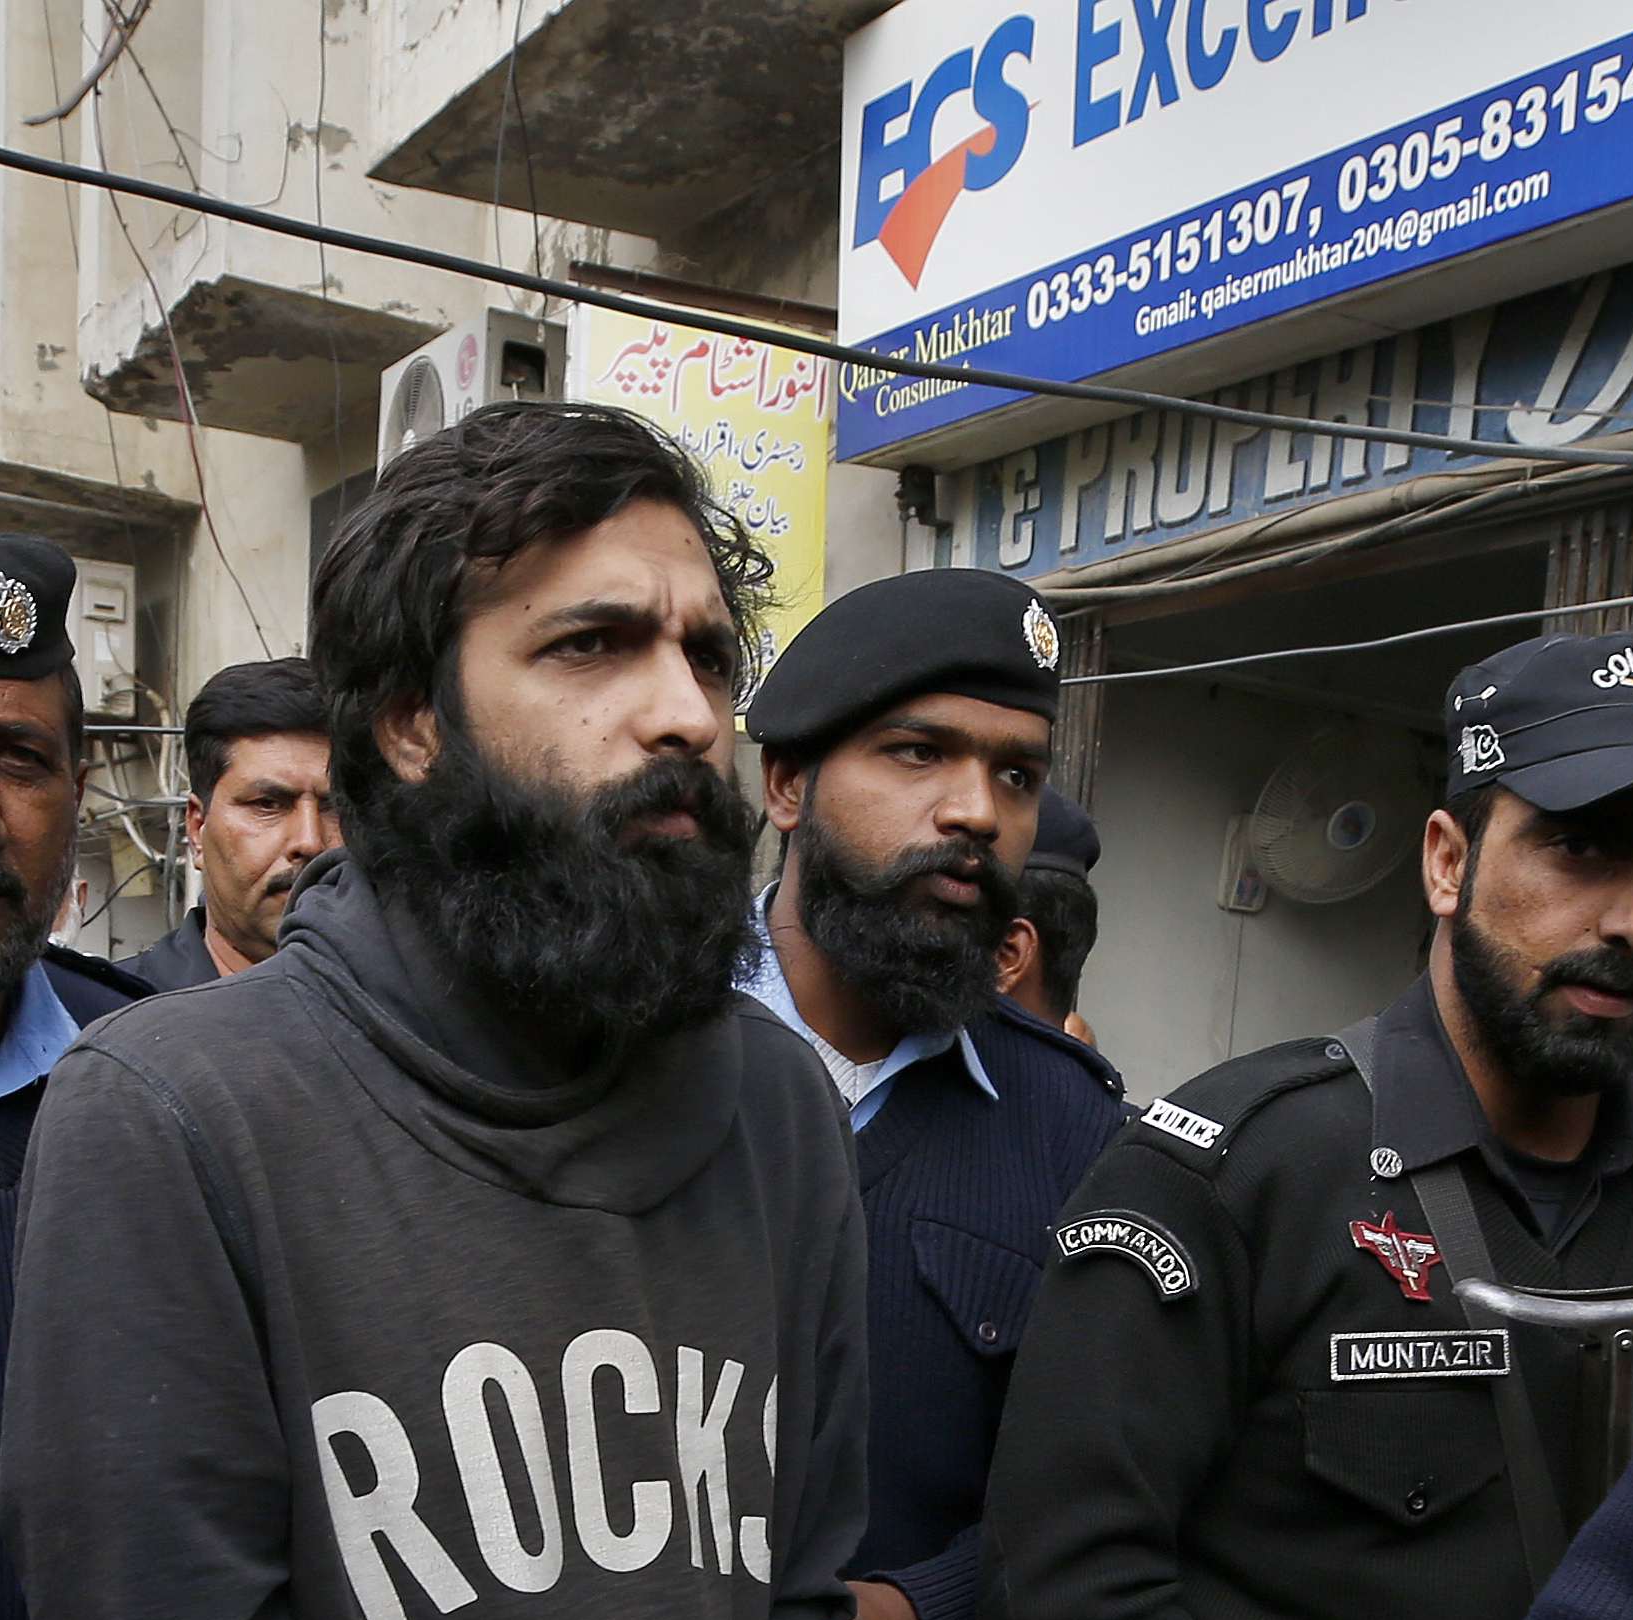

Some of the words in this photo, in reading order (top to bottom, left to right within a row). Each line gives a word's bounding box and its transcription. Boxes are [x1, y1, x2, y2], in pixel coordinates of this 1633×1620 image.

[852, 13, 1037, 251] ECS
[1025, 175, 1323, 330] 0333-5151307,
[1134, 288, 1198, 337] Gmail:
[1200, 169, 1551, 320] qaisermukhtar204@gmail.com
[913, 299, 1017, 367] Mukhtar
[745, 497, 789, 536] بیان
[1141, 1099, 1225, 1149] POLICE
[1065, 1222, 1185, 1290] COMMANDO
[1349, 1335, 1496, 1373] MUNTAZIR
